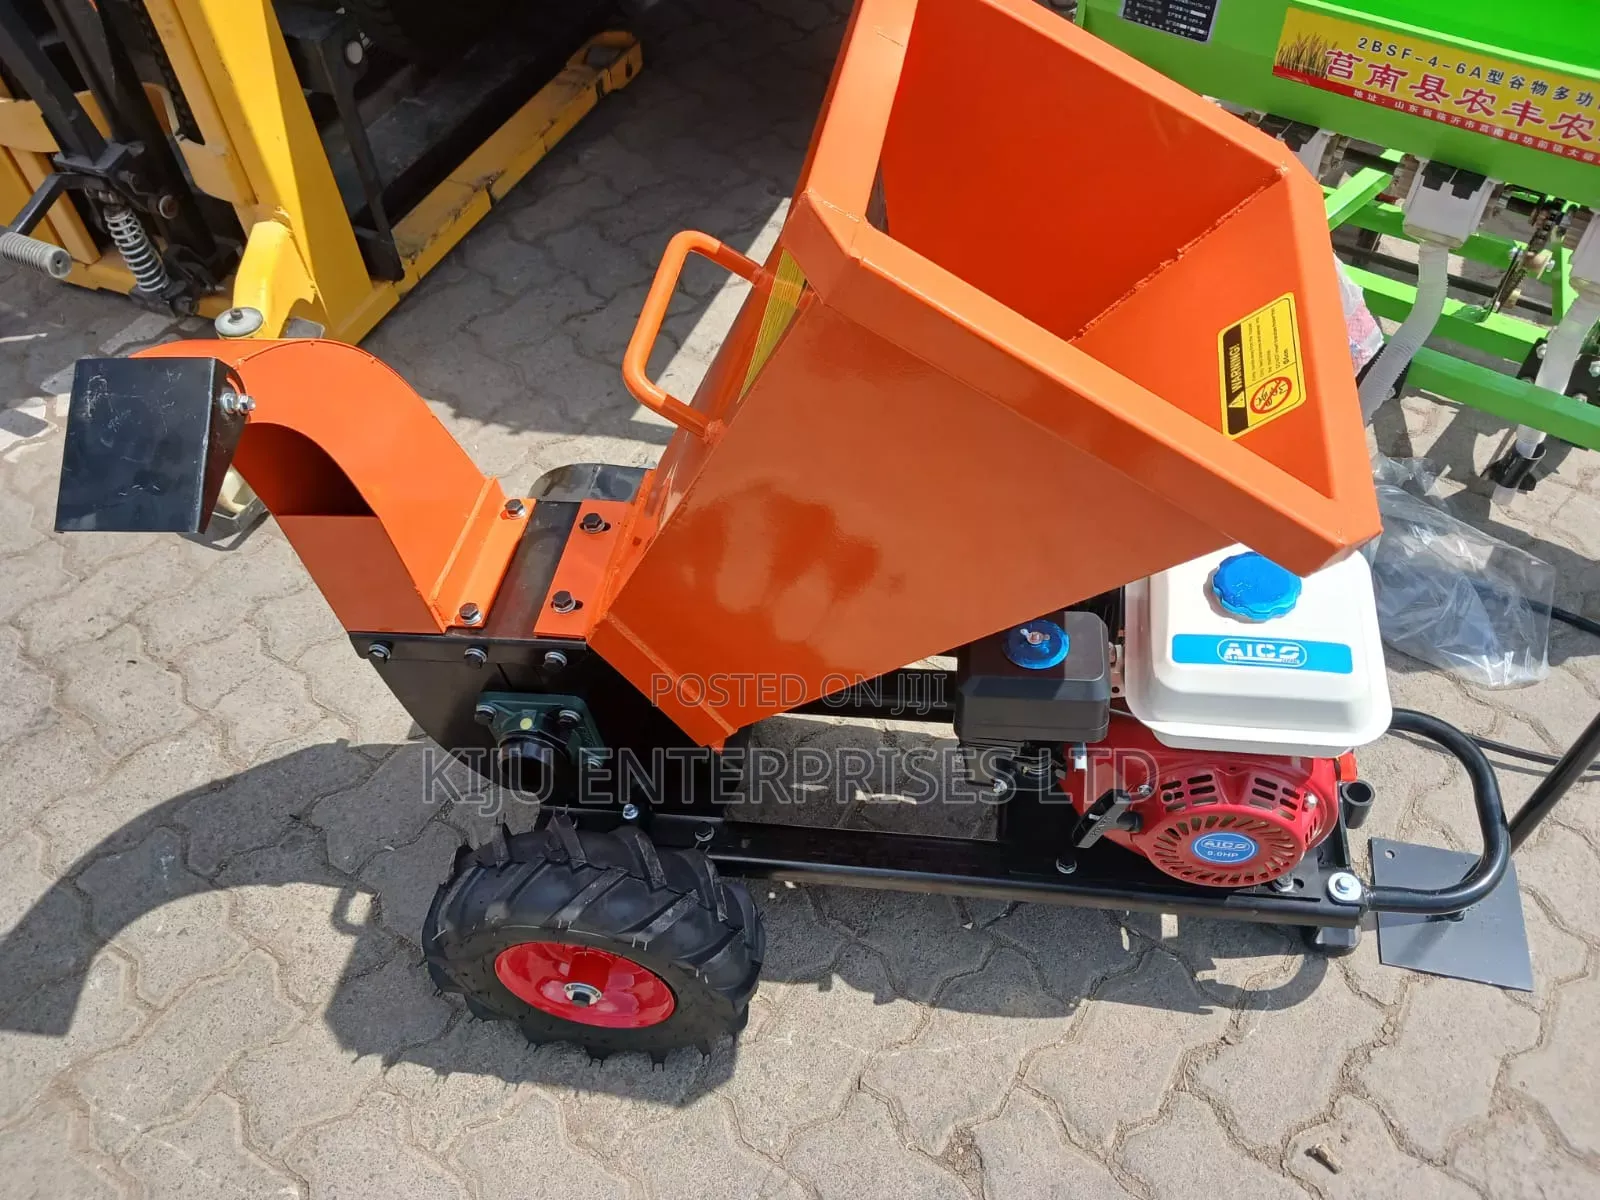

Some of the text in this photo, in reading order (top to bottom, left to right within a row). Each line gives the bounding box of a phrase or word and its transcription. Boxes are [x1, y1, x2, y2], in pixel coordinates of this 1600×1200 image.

[1325, 50, 1600, 142] 莒南县农丰农
[1358, 37, 1600, 110] 2BSF-4-6A型谷物多功
[1228, 343, 1243, 393] WARNING!
